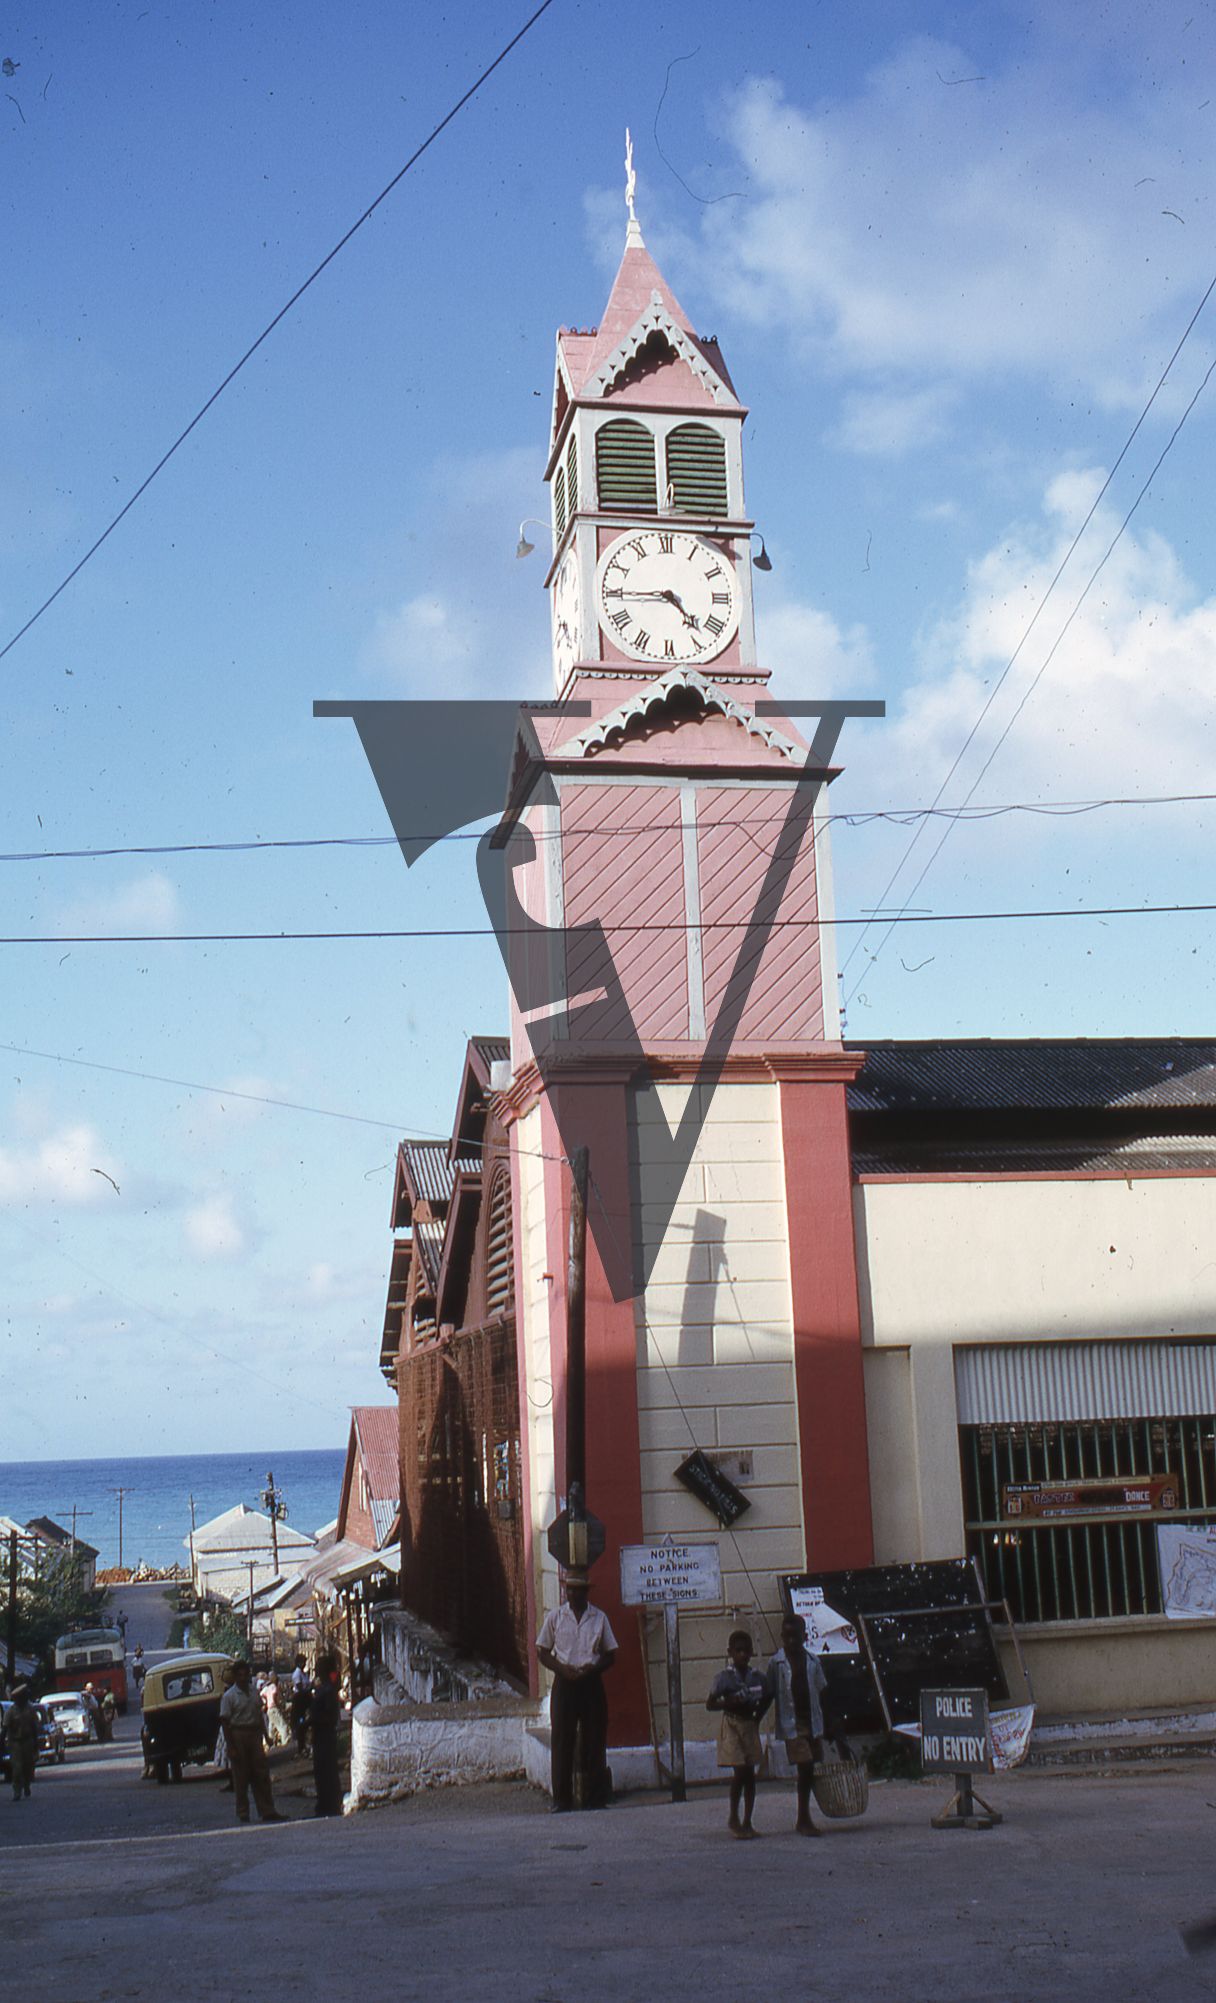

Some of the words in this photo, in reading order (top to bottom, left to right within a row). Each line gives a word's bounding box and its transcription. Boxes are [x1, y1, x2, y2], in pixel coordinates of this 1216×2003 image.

[631, 542, 647, 561] XI
[659, 537, 675, 554] XII
[688, 545, 698, 561] I
[612, 560, 630, 579] X
[704, 566, 721, 581] II
[712, 592, 729, 604] III
[703, 614, 725, 636] IIII
[633, 630, 650, 651] VII
[664, 640, 675, 657] VI
[690, 635, 704, 653] V
[1125, 1491, 1150, 1502] DANCE
[651, 1548, 688, 1559] NOTICE
[640, 1565, 654, 1574] NO
[660, 1562, 699, 1572] PARKING
[646, 1576, 689, 1587] BETWEEN
[640, 1591, 666, 1601] THESE
[672, 1588, 698, 1598] SIGNS
[936, 1696, 973, 1718] POLICE
[924, 1736, 940, 1761] NO
[943, 1736, 985, 1762] ENTRY
